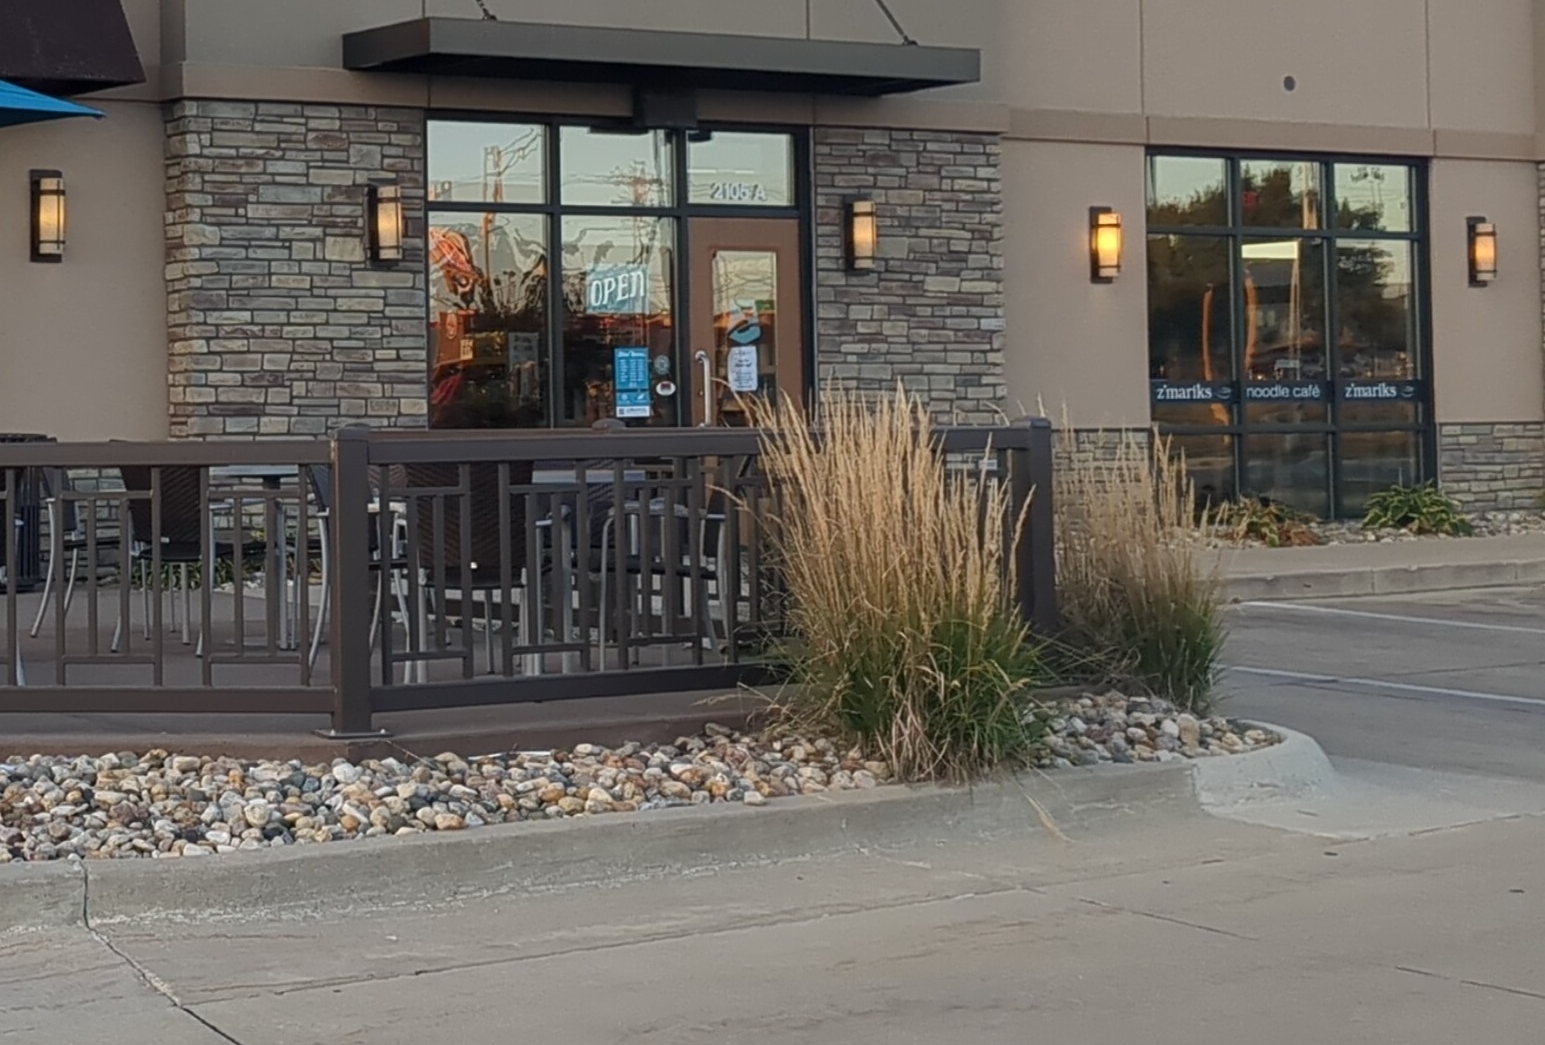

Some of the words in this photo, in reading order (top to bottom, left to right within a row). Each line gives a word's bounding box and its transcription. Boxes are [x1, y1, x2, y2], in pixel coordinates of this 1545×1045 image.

[590, 270, 645, 306] OPEN
[1245, 384, 1291, 399] noodle
[1292, 383, 1321, 399] café
